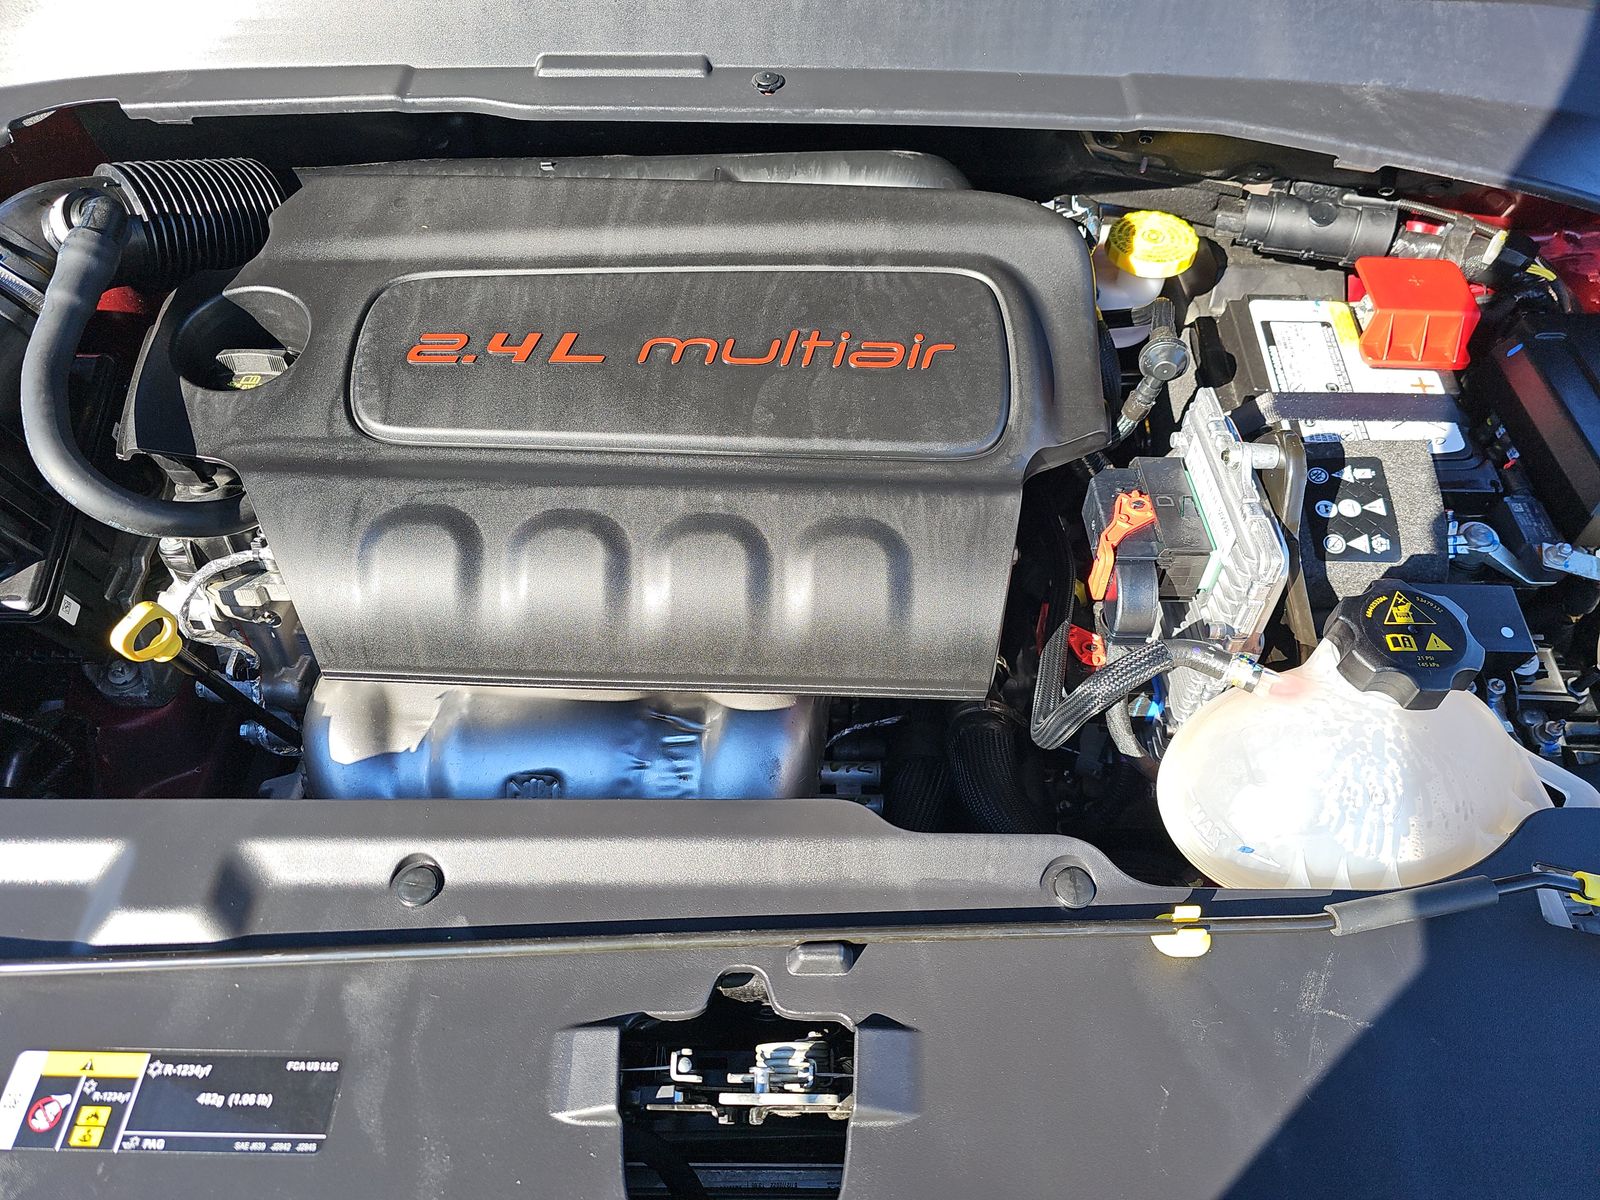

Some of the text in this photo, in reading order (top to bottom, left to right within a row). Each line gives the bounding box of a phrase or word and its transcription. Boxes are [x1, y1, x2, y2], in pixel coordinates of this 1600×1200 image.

[637, 328, 957, 371] multiair
[162, 1063, 213, 1080] R-1234yf
[286, 1060, 340, 1071] FCA US LLC
[141, 1138, 166, 1150] PAG
[233, 1141, 250, 1151] SAE
